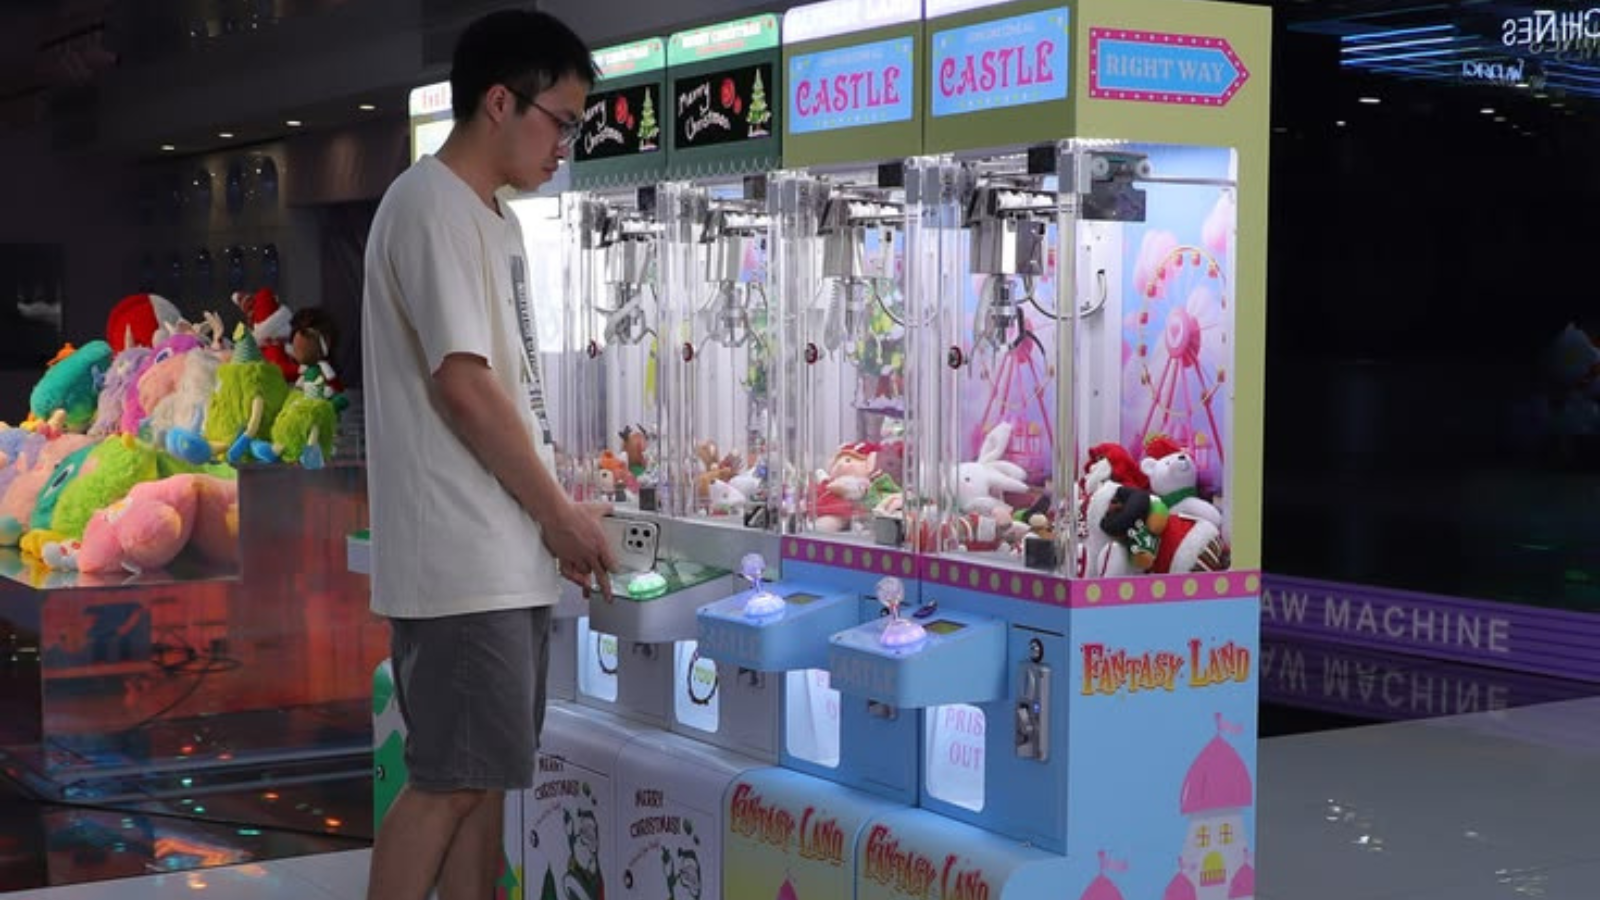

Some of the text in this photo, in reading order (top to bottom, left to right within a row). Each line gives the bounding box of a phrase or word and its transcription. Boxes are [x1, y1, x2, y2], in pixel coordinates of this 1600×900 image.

[795, 66, 901, 117] CASTLE
[938, 39, 1055, 98] CASTLE
[1105, 53, 1225, 83] RIGHT WAY
[582, 99, 607, 131] erry
[1324, 597, 1512, 653] MACHINE
[1080, 642, 1185, 696] FANTASY
[1186, 637, 1252, 690] LAND
[731, 783, 845, 866] FANTASY LAND
[866, 824, 937, 893] FANTASY
